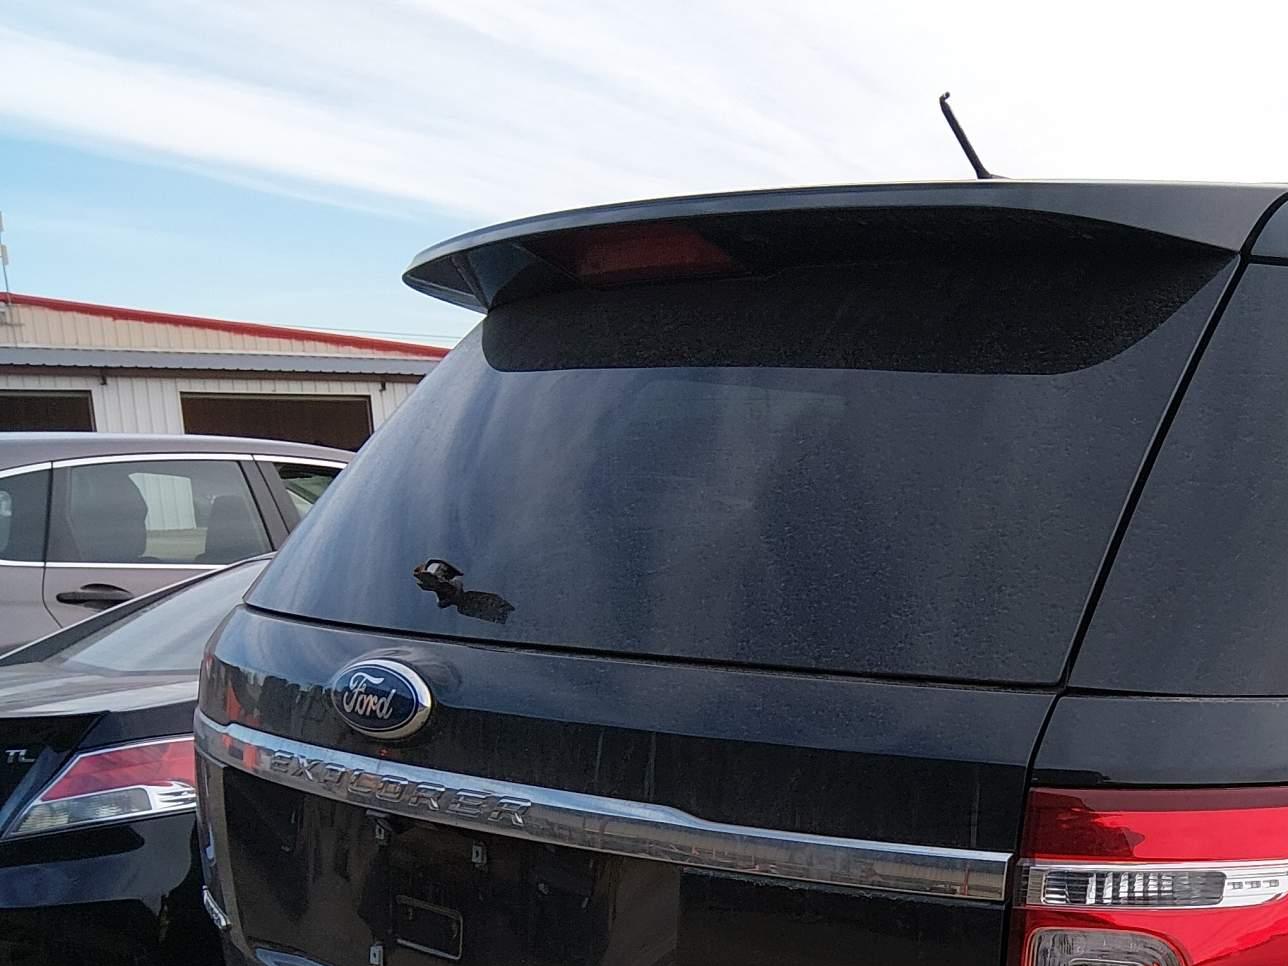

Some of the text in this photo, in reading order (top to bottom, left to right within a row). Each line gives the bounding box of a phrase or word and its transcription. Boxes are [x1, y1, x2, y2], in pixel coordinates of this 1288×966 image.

[342, 671, 397, 720] Ford
[5, 748, 37, 765] TL
[270, 749, 532, 827] EXPLORER
